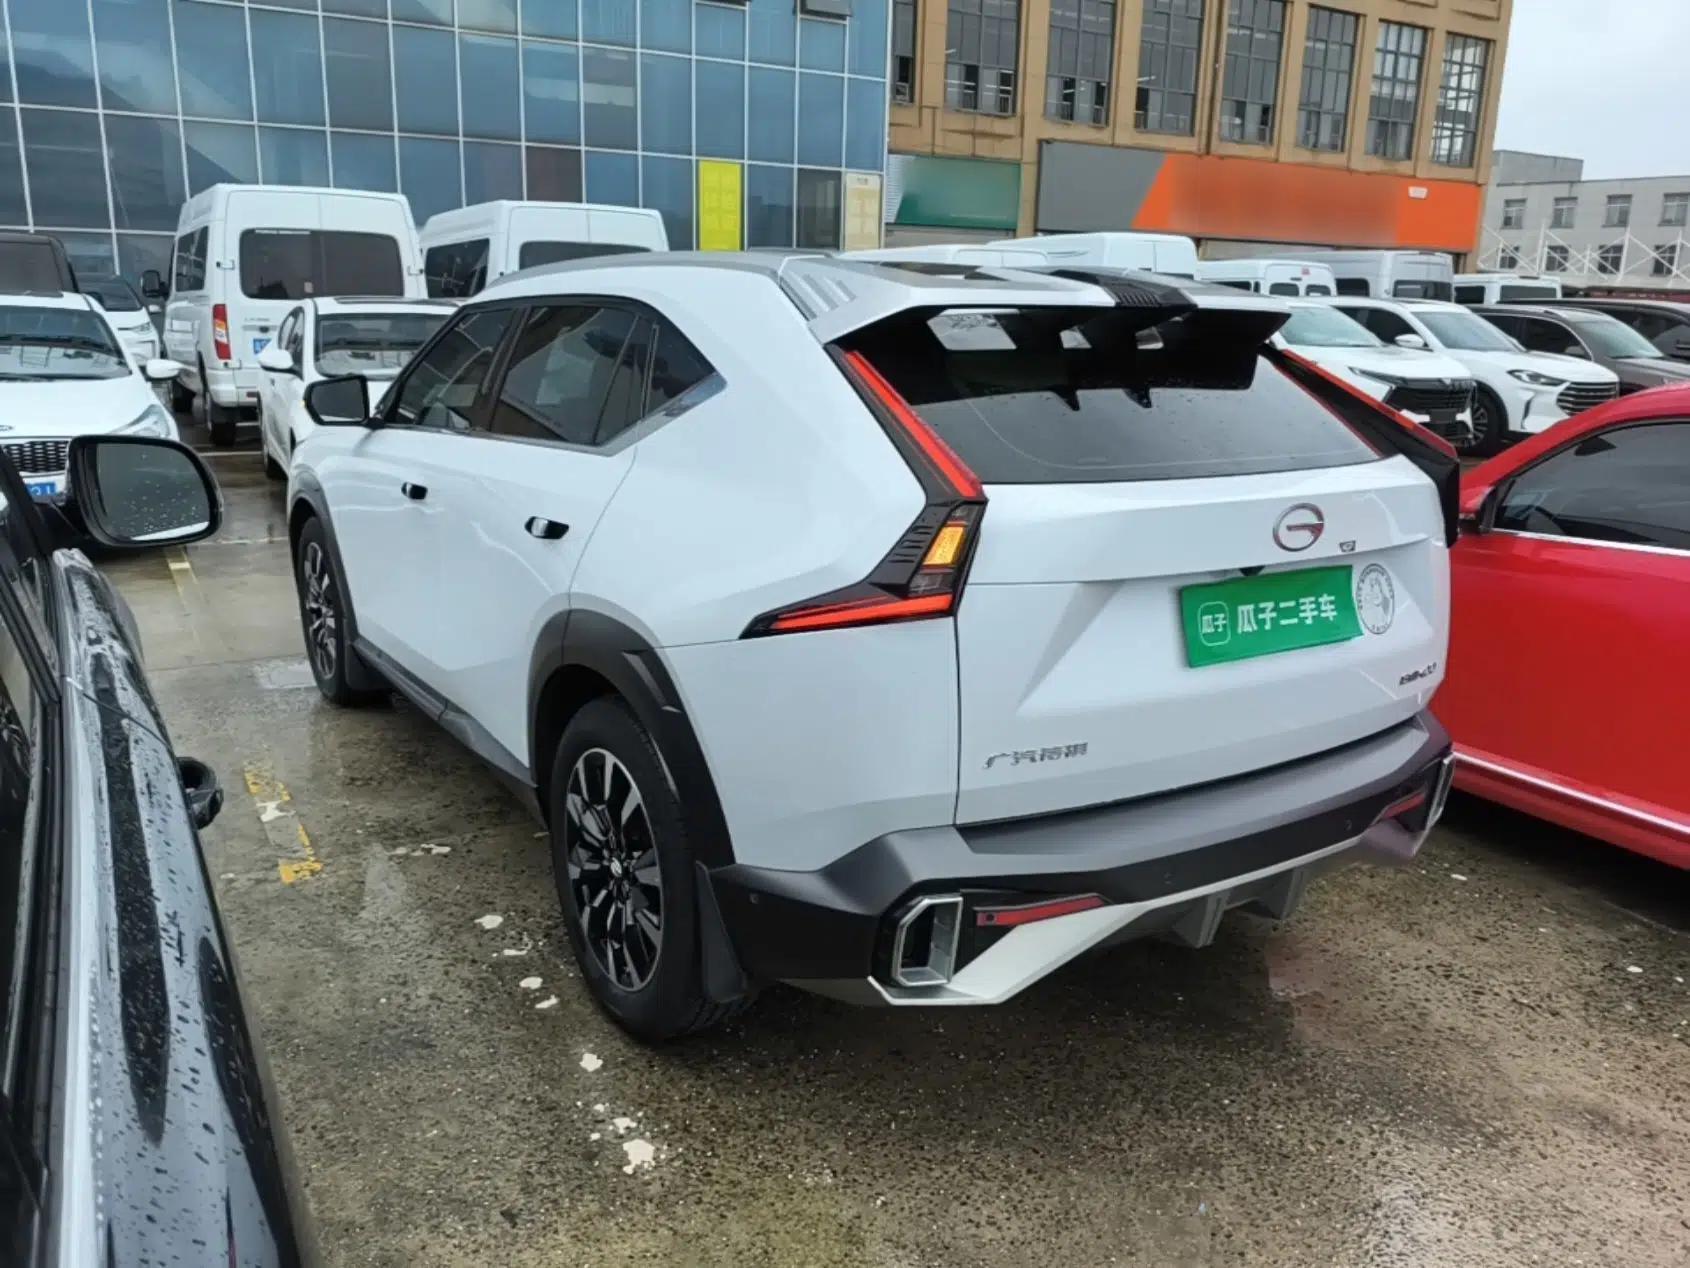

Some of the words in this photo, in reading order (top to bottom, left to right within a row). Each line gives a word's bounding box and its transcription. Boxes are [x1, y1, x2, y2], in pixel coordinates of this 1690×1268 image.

[1201, 613, 1227, 634] 瓜子
[1237, 594, 1338, 634] 瓜子二手车
